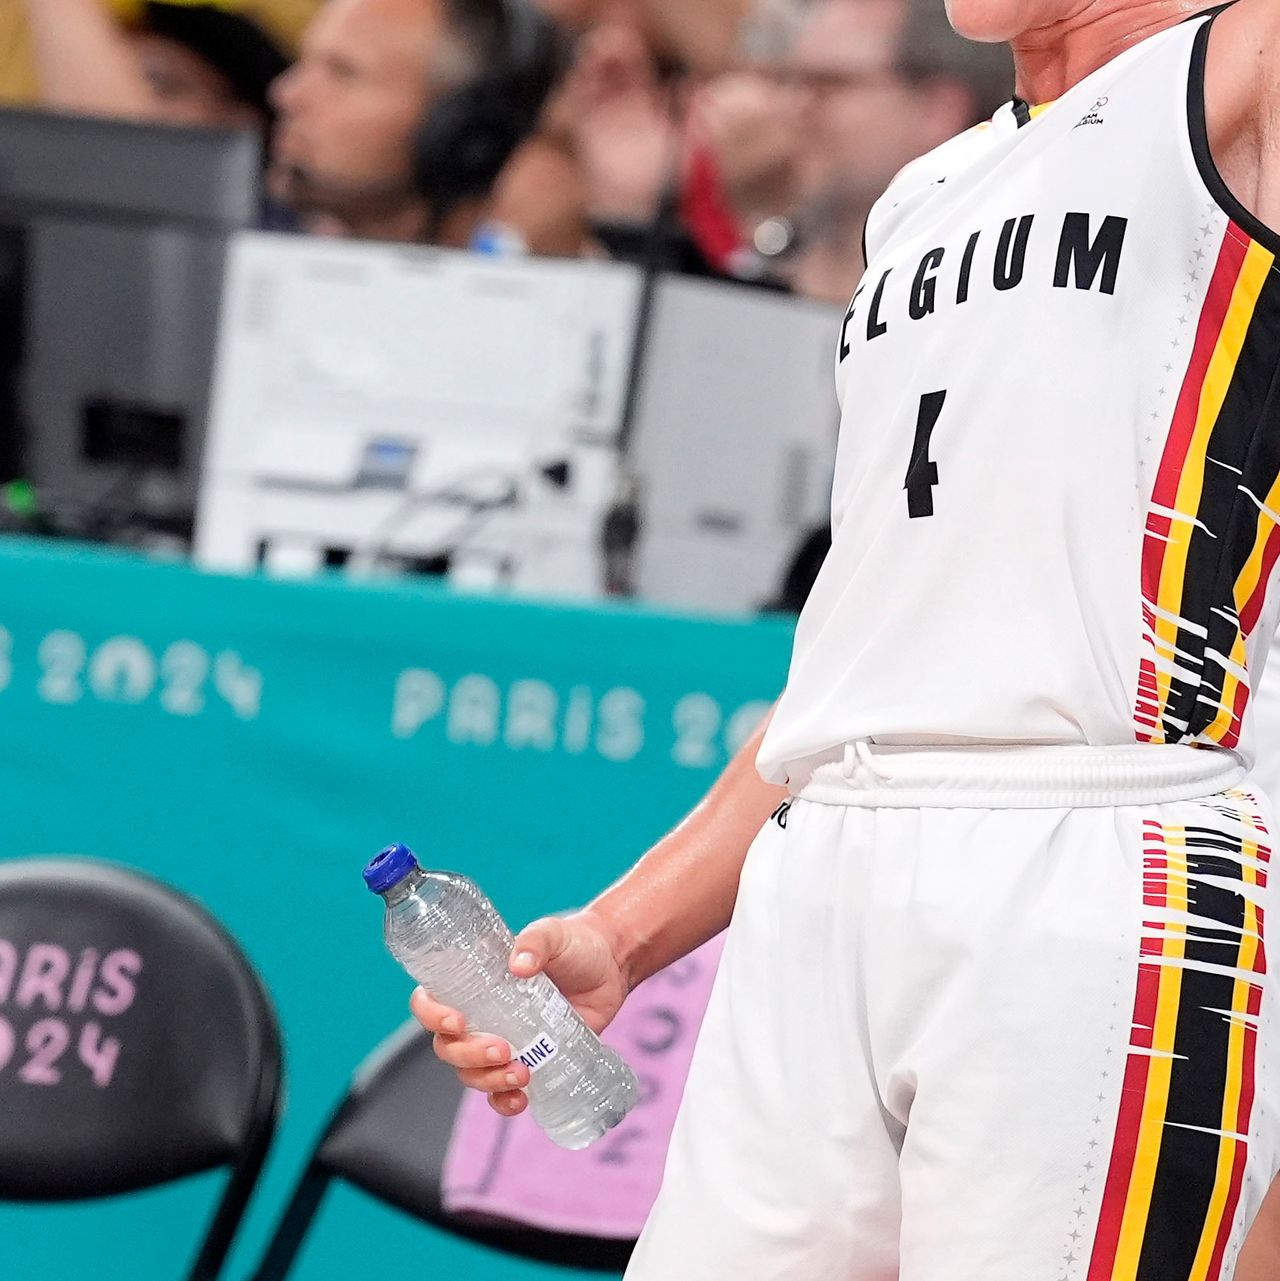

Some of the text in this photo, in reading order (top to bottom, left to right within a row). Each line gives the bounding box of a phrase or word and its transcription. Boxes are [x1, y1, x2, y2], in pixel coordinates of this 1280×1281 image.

[839, 211, 1129, 364] ELGIUM
[36, 628, 263, 720] 2024
[390, 666, 646, 763] PARIS
